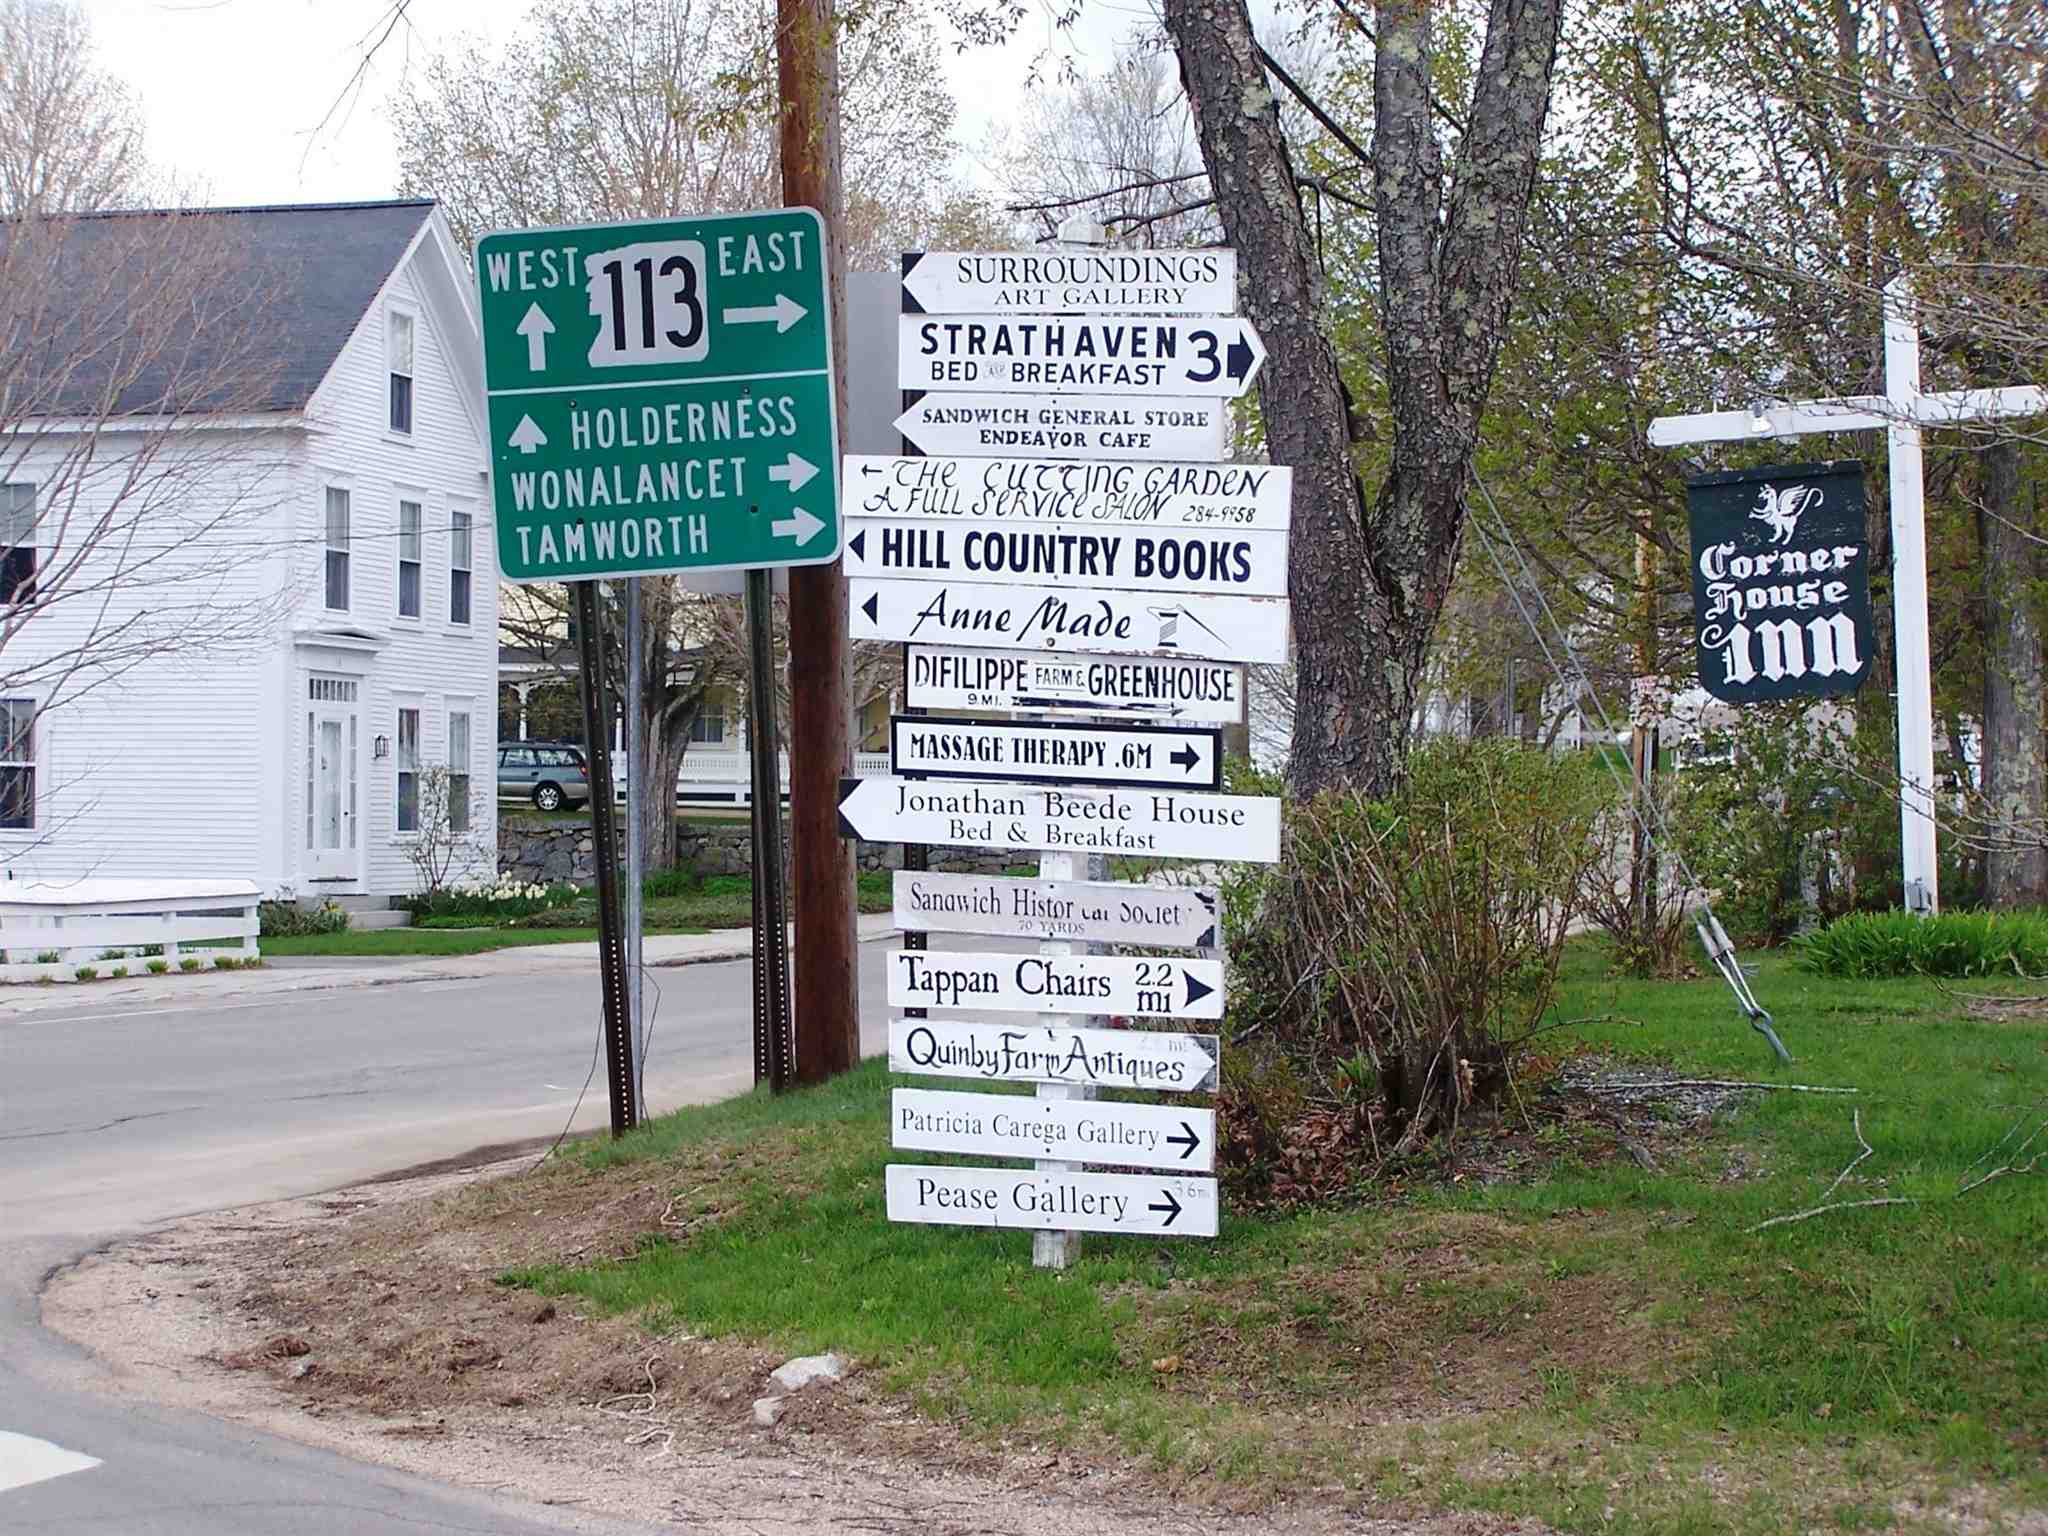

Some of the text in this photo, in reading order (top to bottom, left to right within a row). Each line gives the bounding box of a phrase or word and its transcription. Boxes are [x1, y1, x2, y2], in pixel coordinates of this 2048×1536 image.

[486, 247, 579, 292] WEST
[718, 231, 805, 277] EAST
[957, 256, 1218, 284] SURROUNDINGS
[603, 255, 702, 352] 113
[995, 288, 1188, 305] ART GALLERY
[921, 322, 1222, 383] STRATHAVEN 3
[932, 361, 979, 381] BED
[1012, 363, 1166, 385] BREAKFAST
[571, 396, 798, 450] HOLDERNESS
[922, 408, 1209, 427] SANDWICH GENERAL STORE
[980, 429, 1152, 449] ENDEAVOR CAFE
[511, 457, 746, 511] WONALANCET
[863, 486, 898, 512] A
[905, 487, 964, 515] FULL
[1091, 492, 1173, 520] SALON
[516, 514, 709, 565] TAMWORTH
[881, 528, 1252, 583] HILL COUNTRY BOOKS
[1700, 541, 1858, 580] Corner
[910, 588, 1132, 642] Anne Made
[967, 693, 978, 705] 9
[1036, 667, 1072, 686] FARM
[1076, 670, 1086, 687] &
[1088, 663, 1236, 702] GREENHOUSE
[910, 733, 1004, 764] MASSAGE
[1011, 736, 1107, 768] THERAPY
[895, 785, 1246, 826] Jonathan Beede House
[948, 819, 1156, 850] Bed & Breakfast
[911, 881, 1182, 925] Sandwich Historcal Societ
[899, 956, 999, 1005] Tappan
[1015, 959, 1111, 998] Chairs
[1136, 992, 1172, 1013] mi
[906, 1027, 1186, 1084] Quinby Farm Antiques
[901, 1107, 1160, 1152] Patricia Carega Gallery
[917, 1178, 1129, 1222] Pease Gallery
